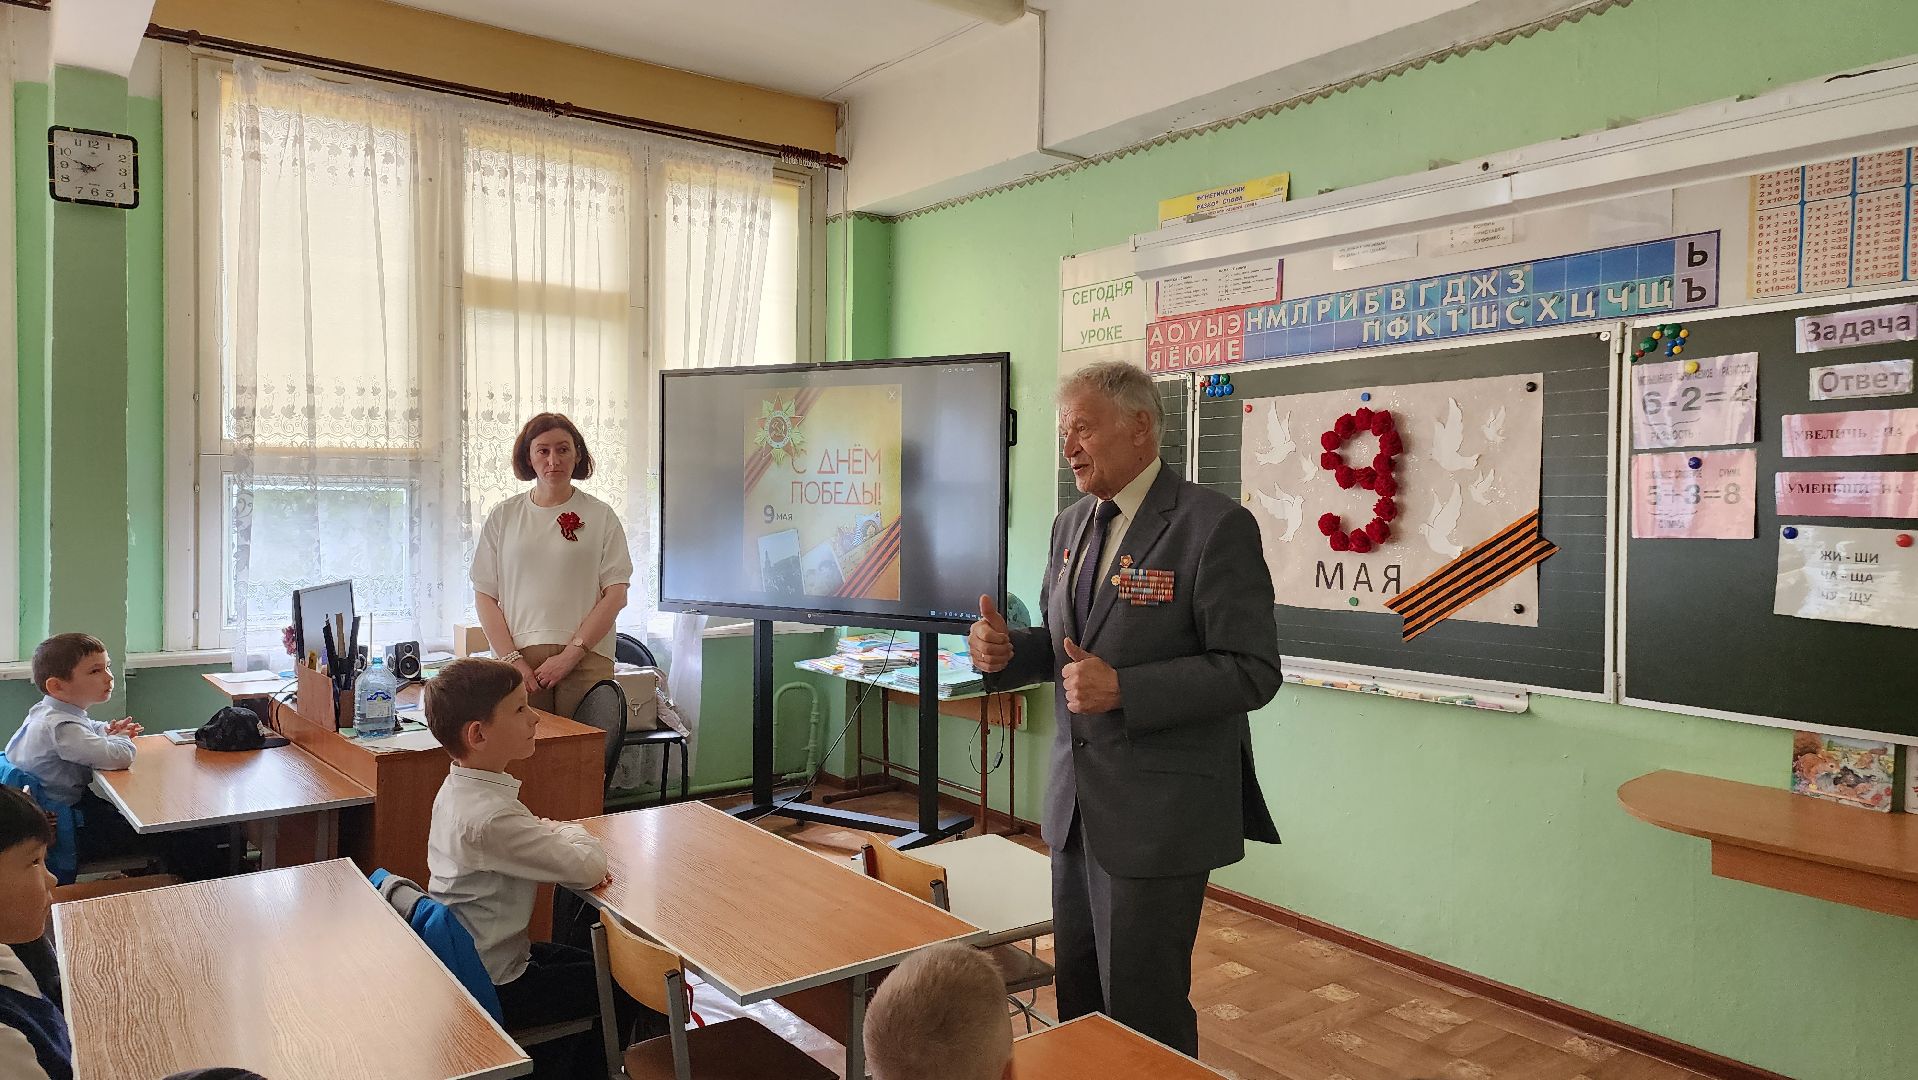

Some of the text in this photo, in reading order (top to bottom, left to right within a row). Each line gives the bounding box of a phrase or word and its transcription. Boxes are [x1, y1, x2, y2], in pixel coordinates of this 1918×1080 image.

[60, 148, 72, 156] 10
[88, 140, 100, 149] 12
[118, 154, 126, 162] 2
[60, 174, 70, 182] 8
[118, 168, 127, 176] 3
[75, 186, 83, 194] 7
[91, 188, 99, 197] 6
[106, 190, 114, 198] 5
[1073, 281, 1133, 305] СЕГОДНЯ
[1093, 307, 1110, 322] НА
[1081, 325, 1122, 344] УРОКЕ
[1806, 315, 1910, 344] Задача
[1819, 372, 1903, 392] Ответ
[792, 444, 881, 474] С ДНЁМ
[1318, 407, 1402, 553] 9
[792, 481, 881, 505] ПОБЕДЫ!
[764, 504, 793, 524] 9 МАЯ
[1315, 561, 1400, 594] МАЯ
